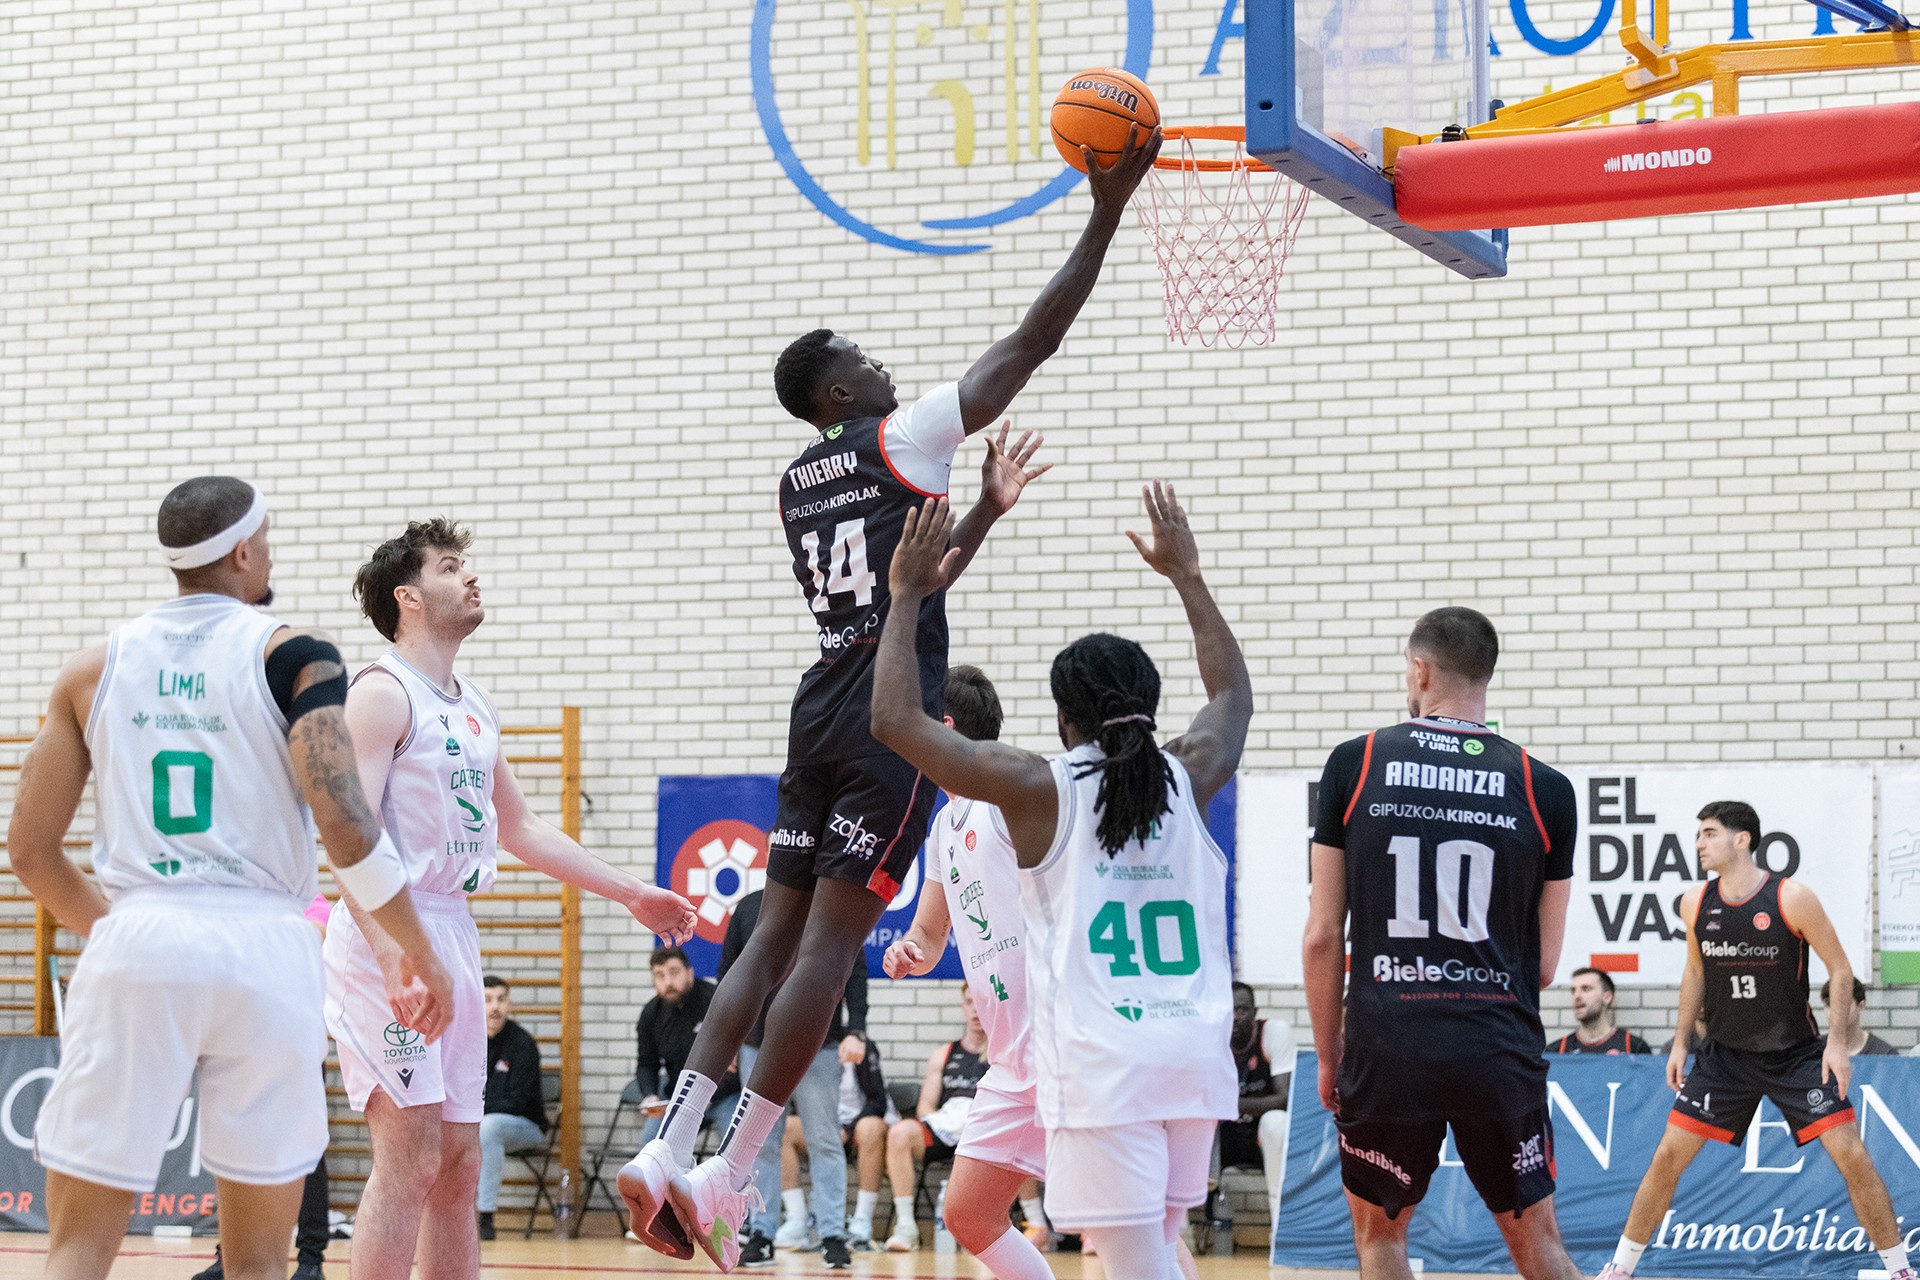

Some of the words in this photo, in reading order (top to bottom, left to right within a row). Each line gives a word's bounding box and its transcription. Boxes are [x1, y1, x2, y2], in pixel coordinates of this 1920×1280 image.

[1070, 80, 1139, 113] Wilson
[1621, 147, 1712, 172] MONDO
[789, 451, 858, 492] THIERRY
[785, 485, 881, 522] GIPUZKOAKIROLAK
[801, 518, 876, 613] 14
[159, 669, 206, 700] LIMA
[1410, 731, 1460, 745] ALTUNA
[1418, 739, 1426, 748] Y
[1429, 741, 1460, 753] URIA
[152, 750, 213, 836] 0
[1385, 761, 1505, 797] ARDANZA
[1369, 803, 1517, 830] GIPUZKOAKIROLAK
[1589, 777, 1656, 824] EL
[1589, 831, 1800, 882] DIAO
[1387, 835, 1495, 942] 10
[1088, 900, 1201, 977] 40
[1701, 940, 1779, 959] BieleGroup
[1373, 954, 1511, 991] BieleGroup
[1730, 975, 1757, 999] 13
[383, 1045, 427, 1058] TOYOTA
[384, 1055, 427, 1065] NOVOMOTOR
